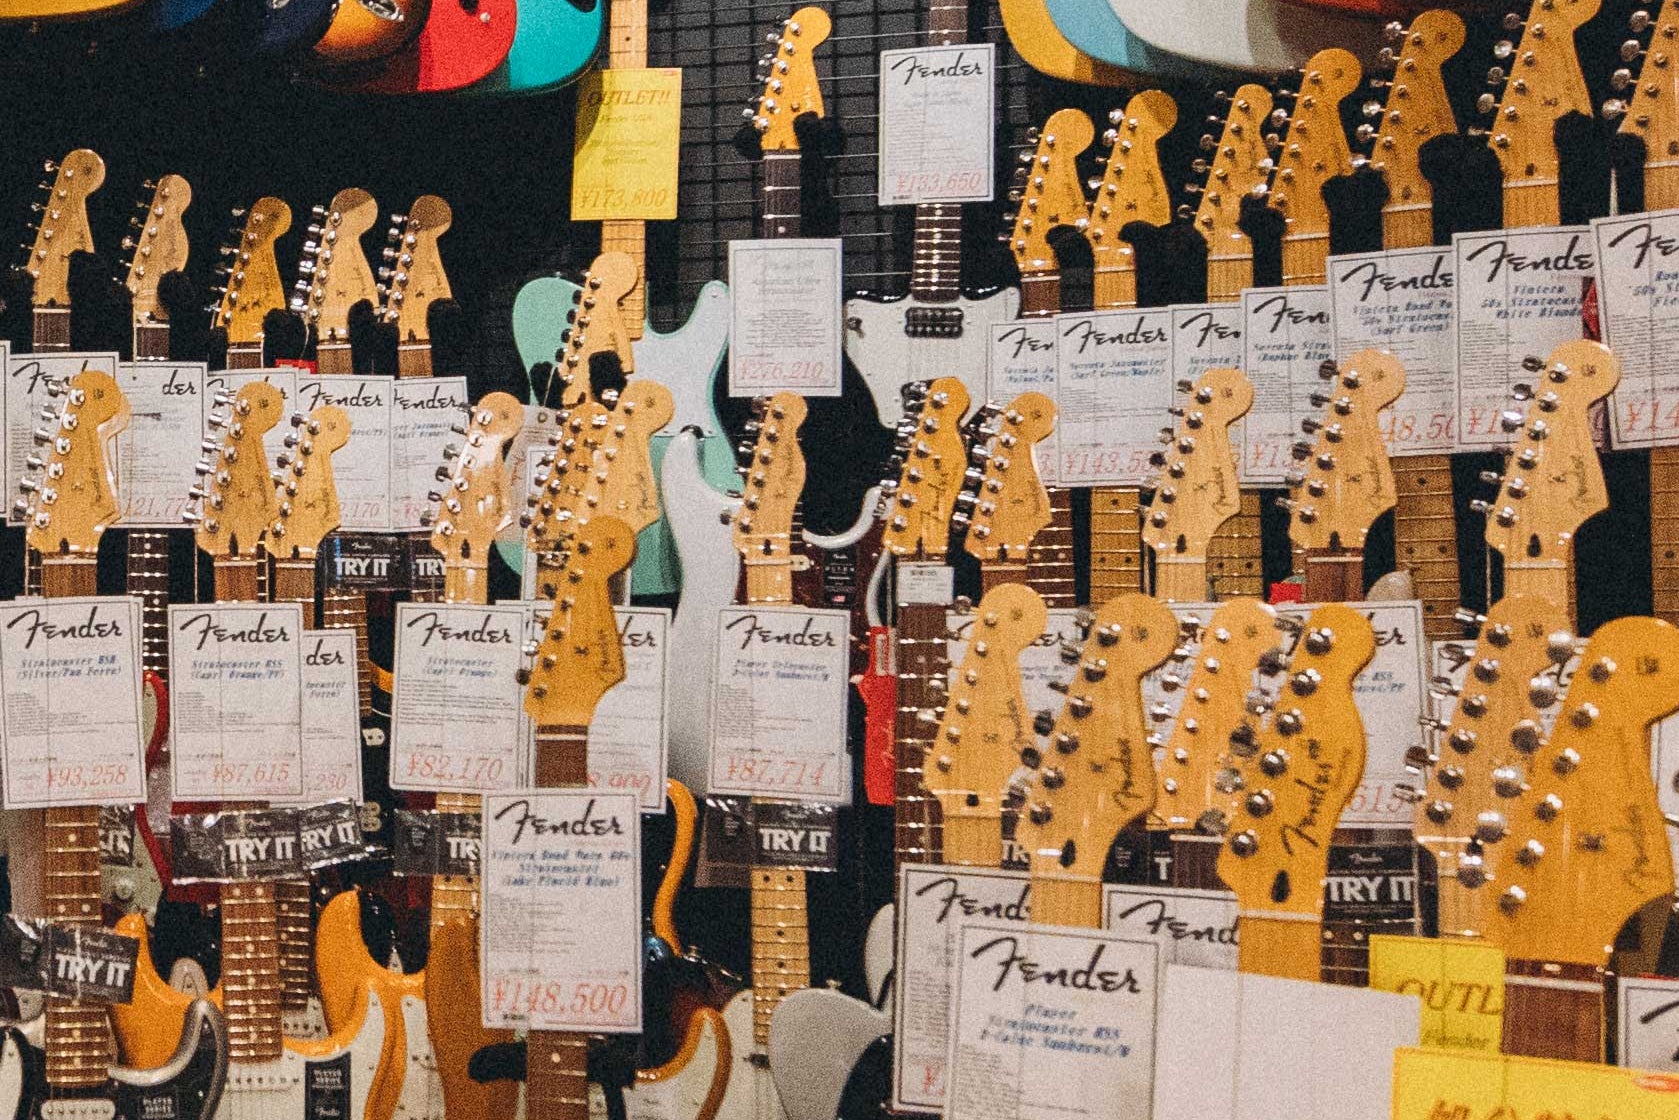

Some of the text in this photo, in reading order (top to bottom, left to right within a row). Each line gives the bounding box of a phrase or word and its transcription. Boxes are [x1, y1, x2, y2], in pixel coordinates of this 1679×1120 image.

[891, 52, 983, 86] Fender
[1466, 236, 1594, 282] Fende
[1340, 255, 1454, 302] Fende
[1063, 317, 1168, 354] Fender
[162, 369, 196, 396] der
[299, 383, 384, 410] Fender
[335, 558, 390, 578] TRY IT
[7, 606, 123, 649] Fender
[180, 613, 291, 650] Fender
[407, 612, 513, 648] Fender
[726, 614, 837, 650] Fender
[306, 639, 346, 667] der
[46, 763, 127, 788] ¥93,258
[211, 763, 290, 784] ¥87,615
[407, 754, 504, 784] ¥82,170
[495, 799, 624, 845] Fender
[1280, 758, 1333, 857] Fender
[224, 837, 298, 862] TRY IT
[758, 826, 832, 853] TRY IT
[1325, 875, 1414, 903] TRY IT
[1120, 900, 1240, 945] Fend
[56, 953, 130, 988] TRY IT
[971, 938, 1141, 994] Fender
[493, 978, 628, 1015] ¥148,500
